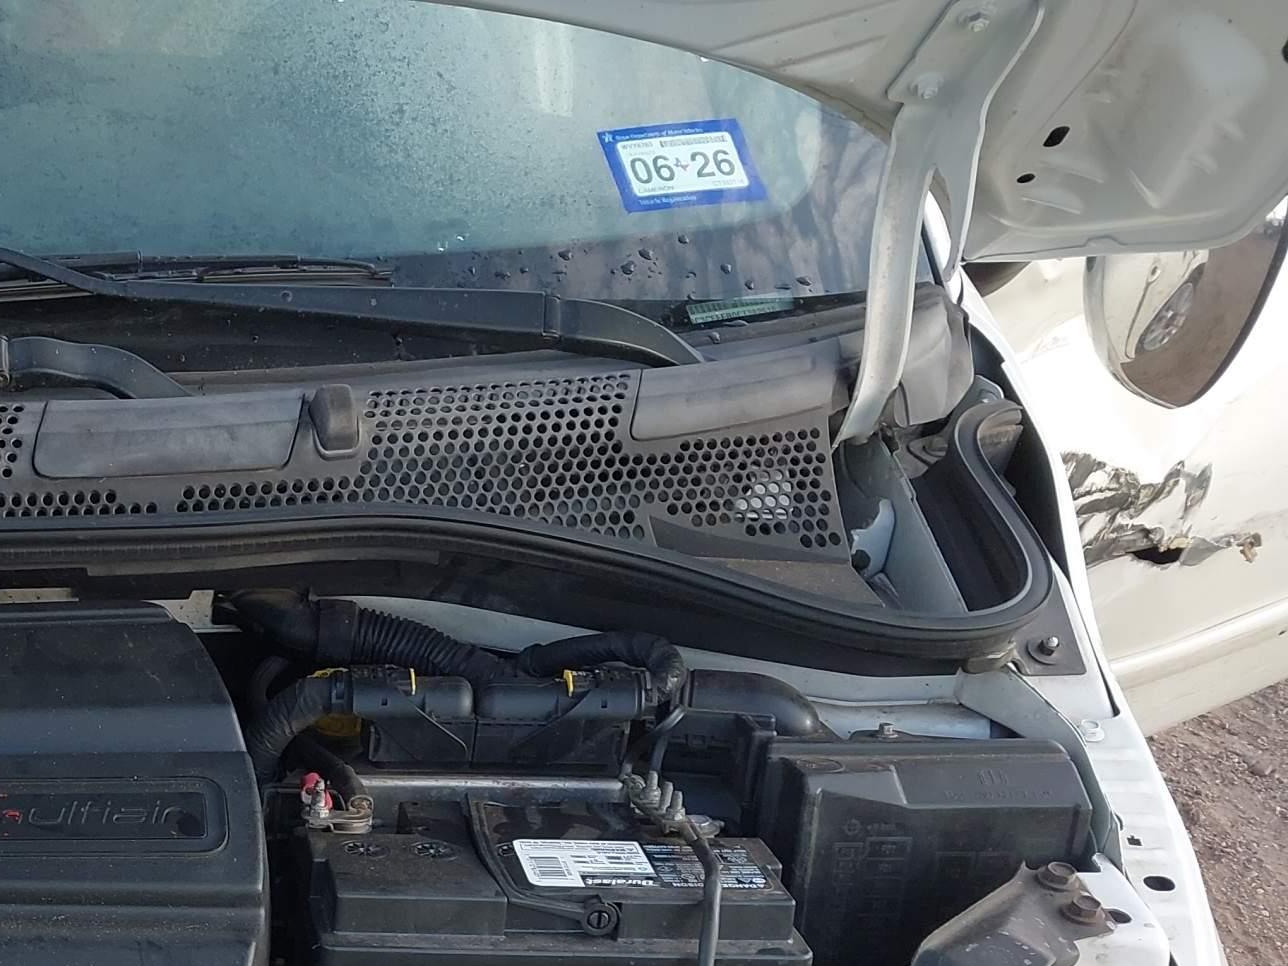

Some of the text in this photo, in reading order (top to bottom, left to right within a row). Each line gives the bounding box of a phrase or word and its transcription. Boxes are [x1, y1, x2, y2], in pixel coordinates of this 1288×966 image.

[630, 149, 736, 184] 06 26
[583, 877, 657, 888] Duralast
